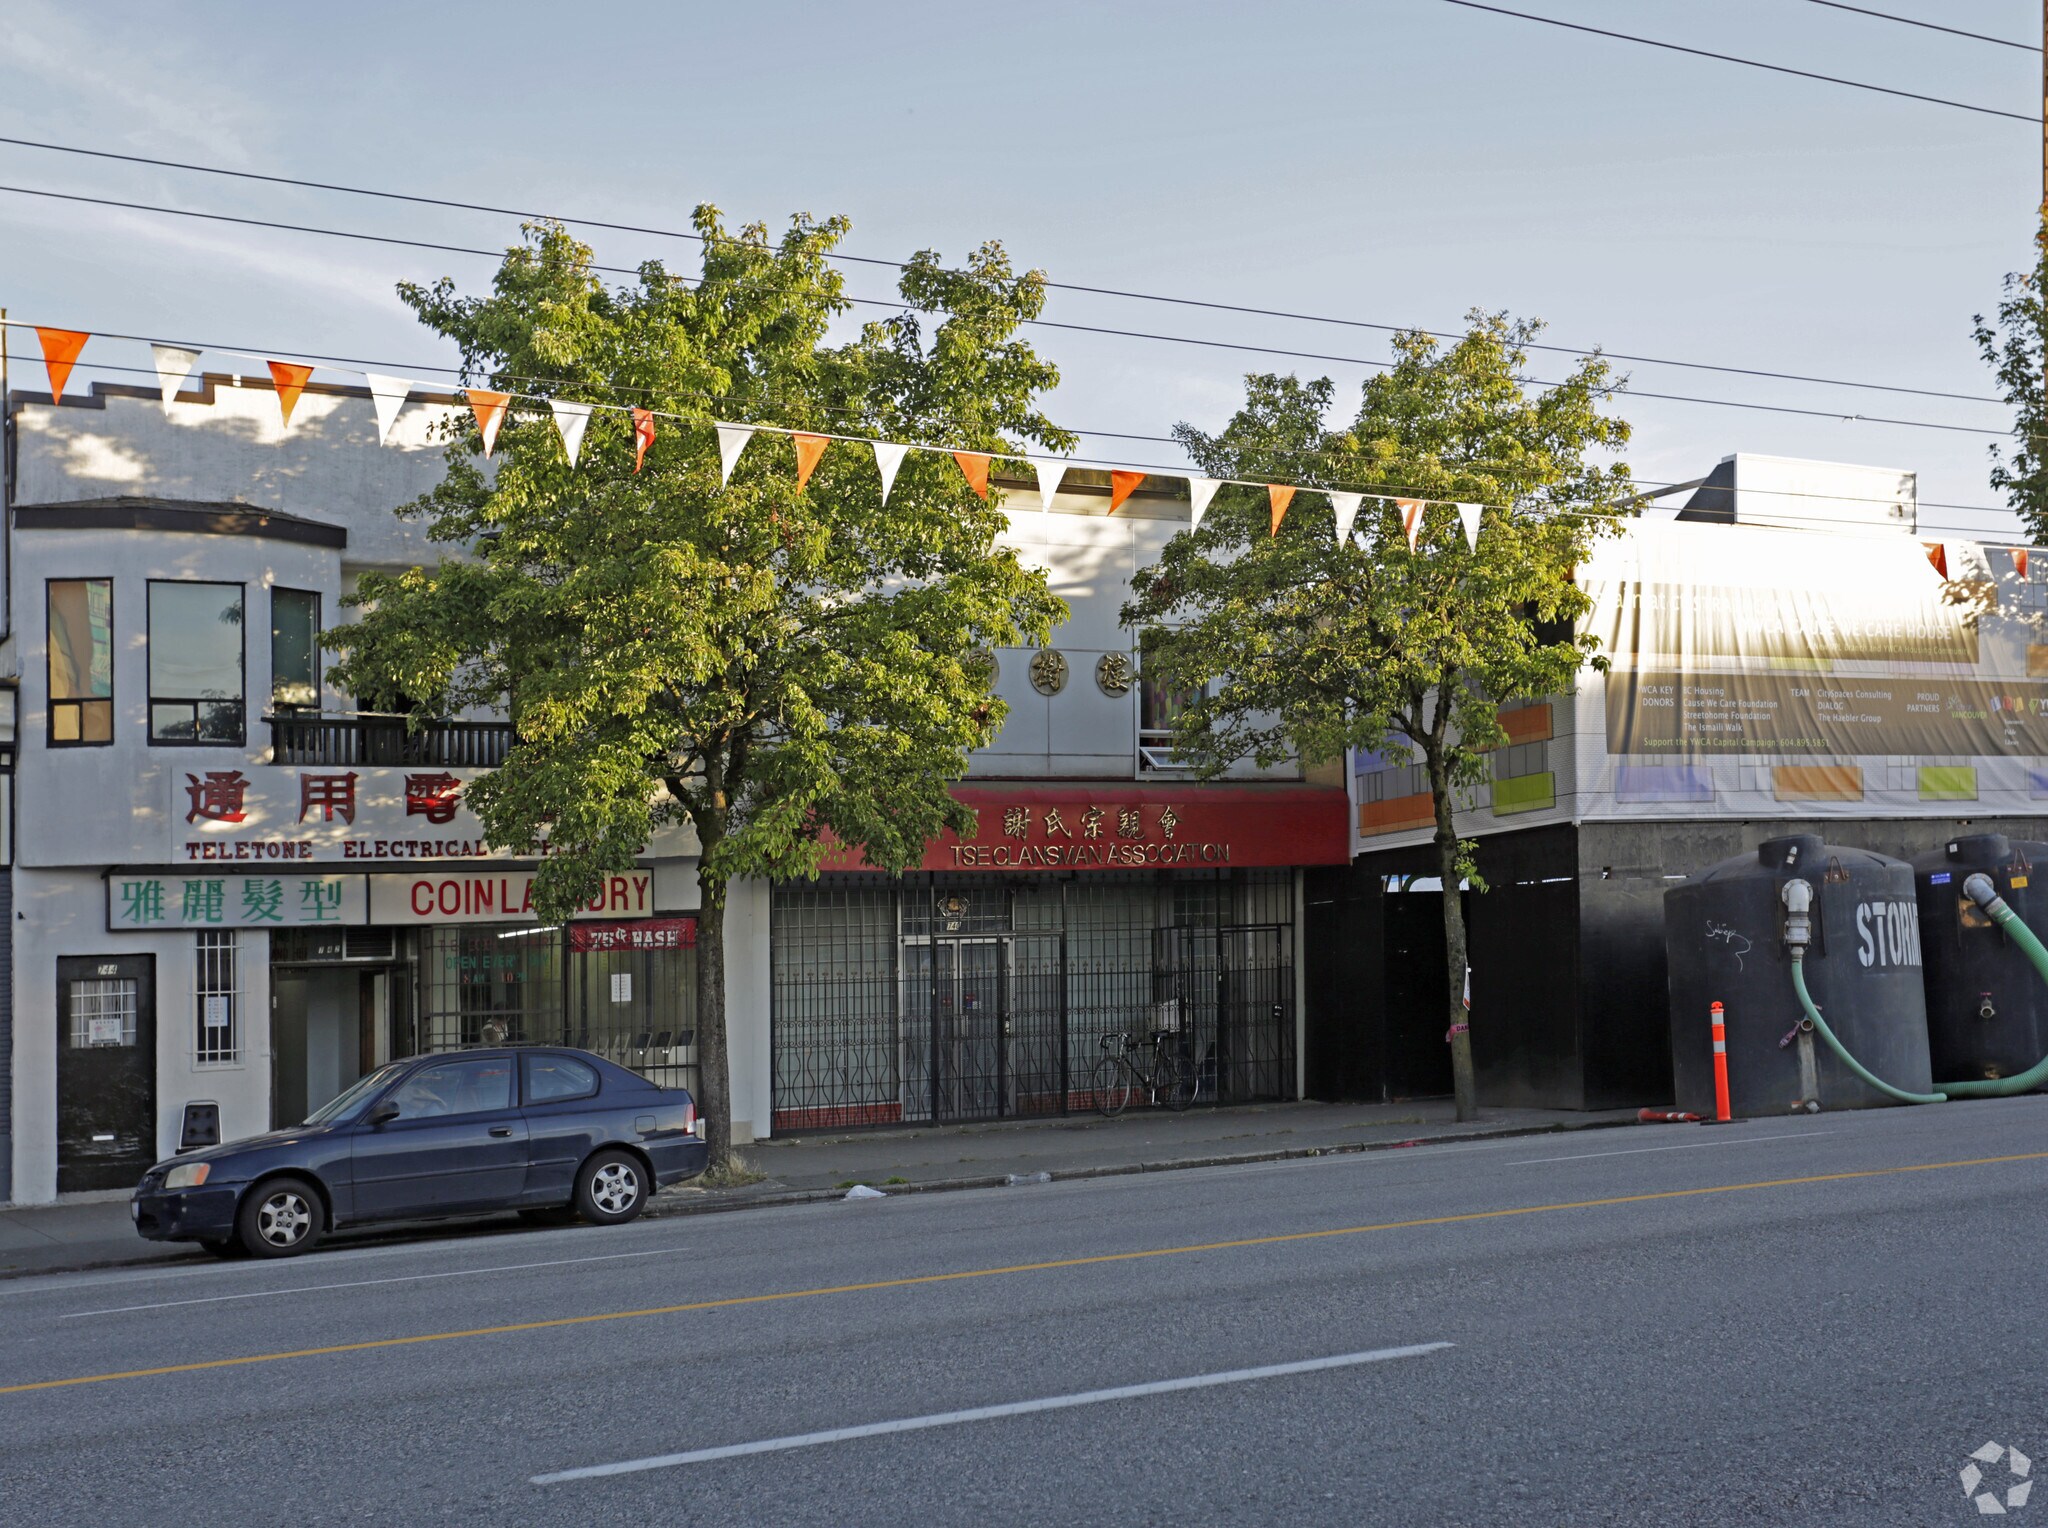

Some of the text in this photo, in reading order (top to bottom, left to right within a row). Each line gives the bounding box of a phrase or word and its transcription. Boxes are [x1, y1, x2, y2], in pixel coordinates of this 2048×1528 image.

[1865, 622, 1901, 639] CARE
[1906, 623, 1951, 640] HOUSE
[1883, 646, 1902, 654] YWCA
[1904, 646, 1932, 656] Housing
[1660, 686, 1674, 694] KEY
[1695, 687, 1725, 697] Housing
[1791, 688, 1810, 697] TEAM
[1855, 690, 1892, 700] Consulting
[1917, 692, 1940, 701] PROUD
[1643, 698, 1674, 707] DONORS
[1683, 699, 1778, 709] Cause We Care Foundation
[1817, 702, 1844, 711] DIALOG
[1907, 704, 1940, 713] PARTNERS
[1683, 711, 1771, 721] Streetohome Foundation
[1819, 713, 1882, 724] The Haebler Group
[1951, 711, 1988, 720] VANCOUVER
[1684, 723, 1697, 731] The
[1726, 723, 1743, 732] Walk
[1643, 737, 1674, 747] Support
[1676, 737, 1687, 746] the
[1689, 738, 1711, 746] YWCA
[1713, 738, 1739, 747] Capital
[1003, 805, 1182, 841] 謝氏宗親會
[186, 839, 488, 860] TELETONE ELECTRICAL
[950, 842, 1230, 867] TSE CLANSMAN ASSOCIATION
[120, 878, 342, 924] 雅麗髮型
[631, 931, 679, 948] WASH
[445, 955, 476, 970] OPEN
